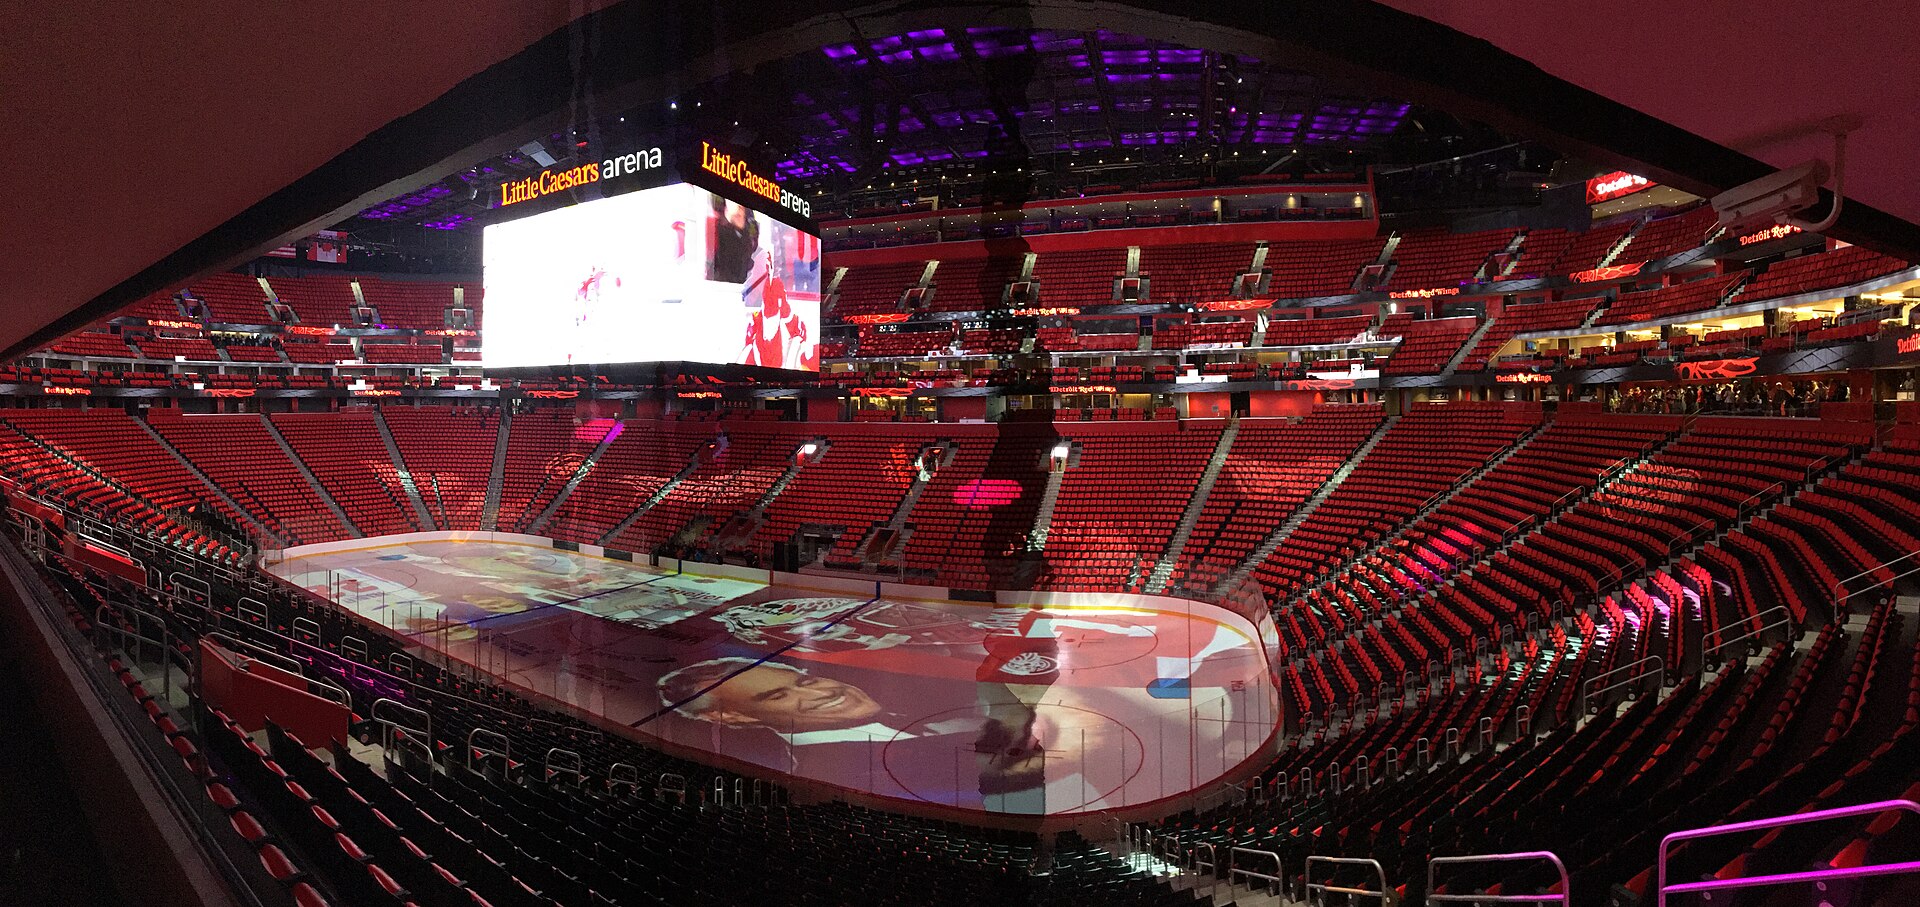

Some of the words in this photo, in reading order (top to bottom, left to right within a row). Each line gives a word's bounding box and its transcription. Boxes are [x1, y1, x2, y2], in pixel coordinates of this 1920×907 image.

[501, 177, 539, 206] Little
[539, 163, 599, 196] Caesars
[602, 147, 662, 179] arena
[702, 140, 737, 182] Little
[737, 160, 780, 203] Caesars
[781, 189, 811, 218] arena
[1740, 229, 1771, 245] Detroit
[1771, 224, 1791, 238] Red
[1389, 290, 1419, 298] Detroit
[1419, 288, 1435, 298] Red
[1435, 287, 1460, 296] Wings
[1013, 307, 1039, 315] Detroit
[1039, 307, 1057, 316] Red
[1057, 307, 1081, 315] Wings
[147, 319, 169, 327] Detroit
[170, 320, 182, 329] Red
[182, 321, 203, 329] Wings
[1496, 374, 1517, 382] Detroit
[1517, 373, 1531, 384] Red
[1531, 373, 1553, 383] Wings
[1078, 386, 1094, 394] Red
[1093, 385, 1117, 393] Wings
